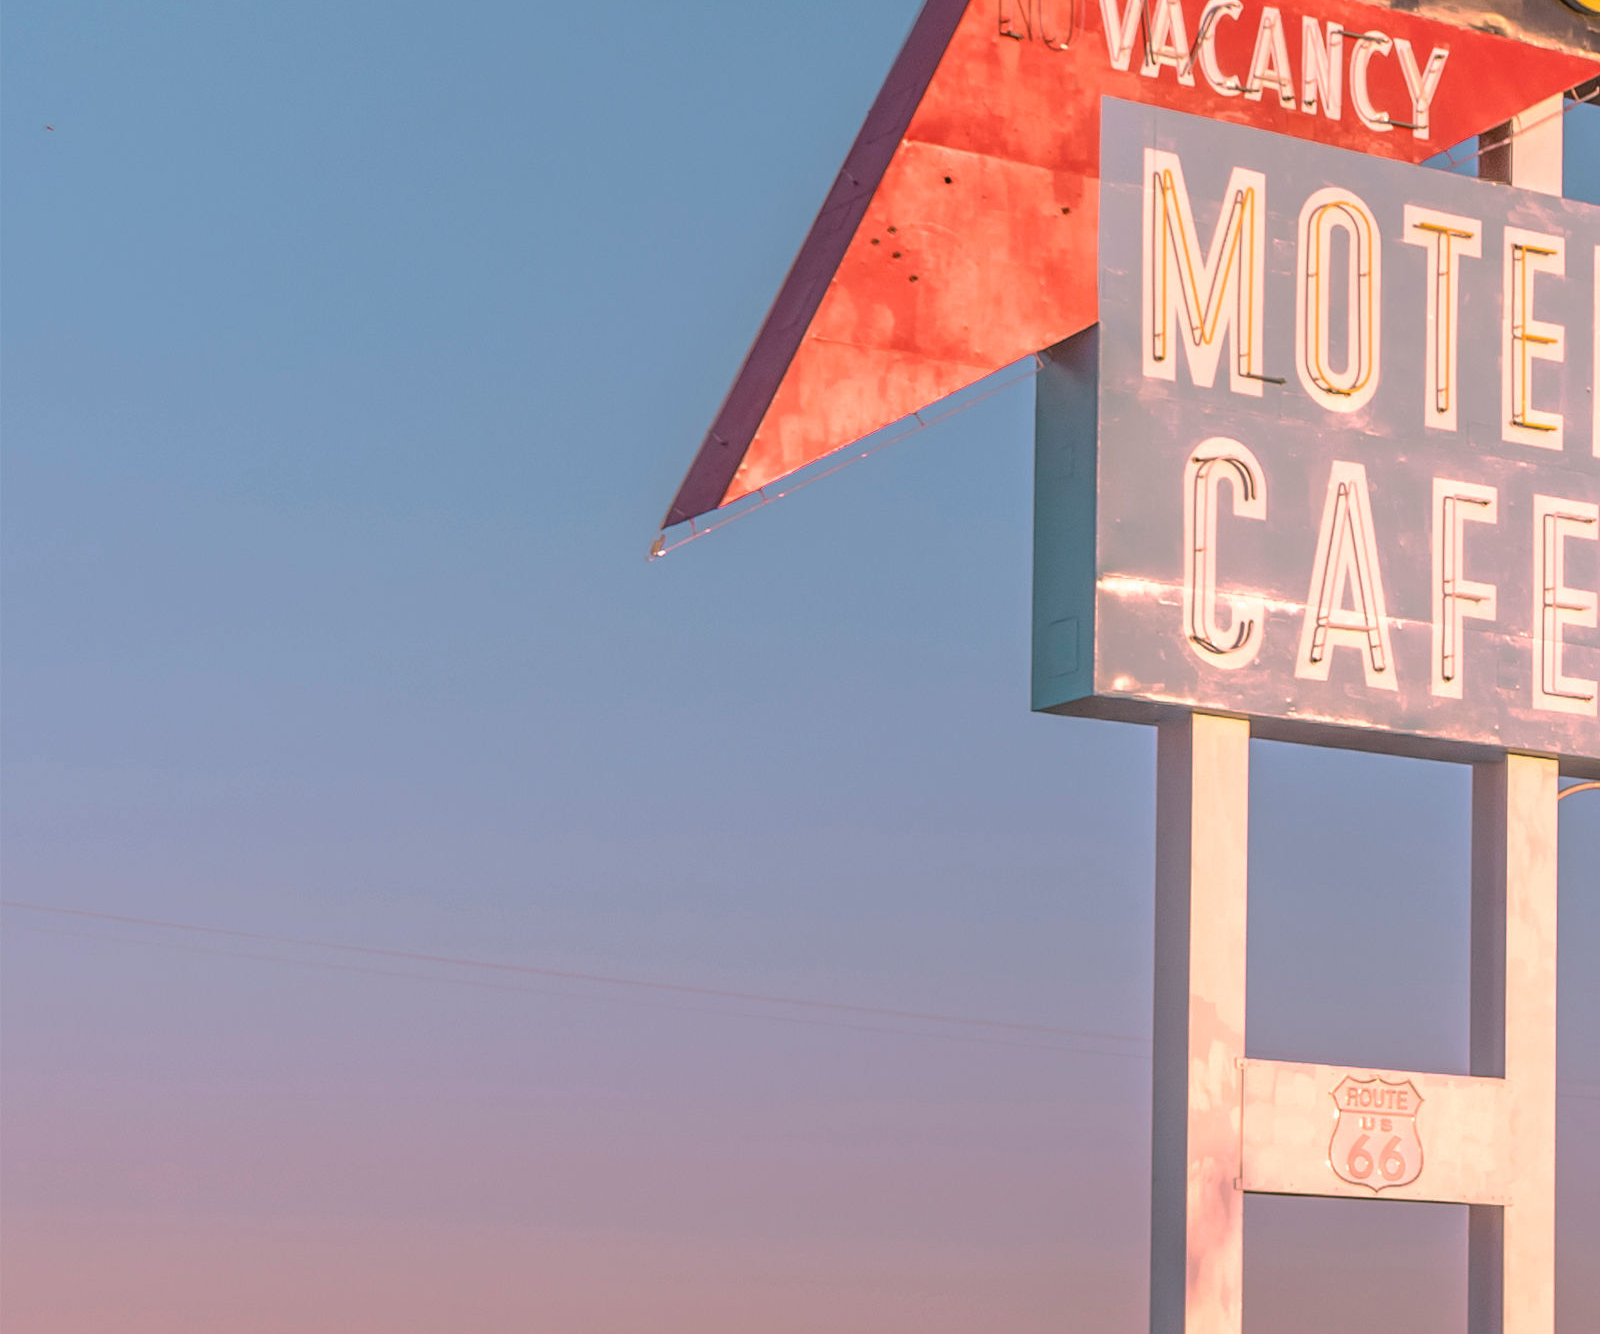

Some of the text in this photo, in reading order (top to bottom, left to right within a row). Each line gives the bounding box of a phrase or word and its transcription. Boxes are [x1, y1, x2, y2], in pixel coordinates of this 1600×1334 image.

[1183, 436, 1599, 716] CAFE
[1346, 1087, 1408, 1111] ROUTE
[1347, 1134, 1406, 1182] 66
